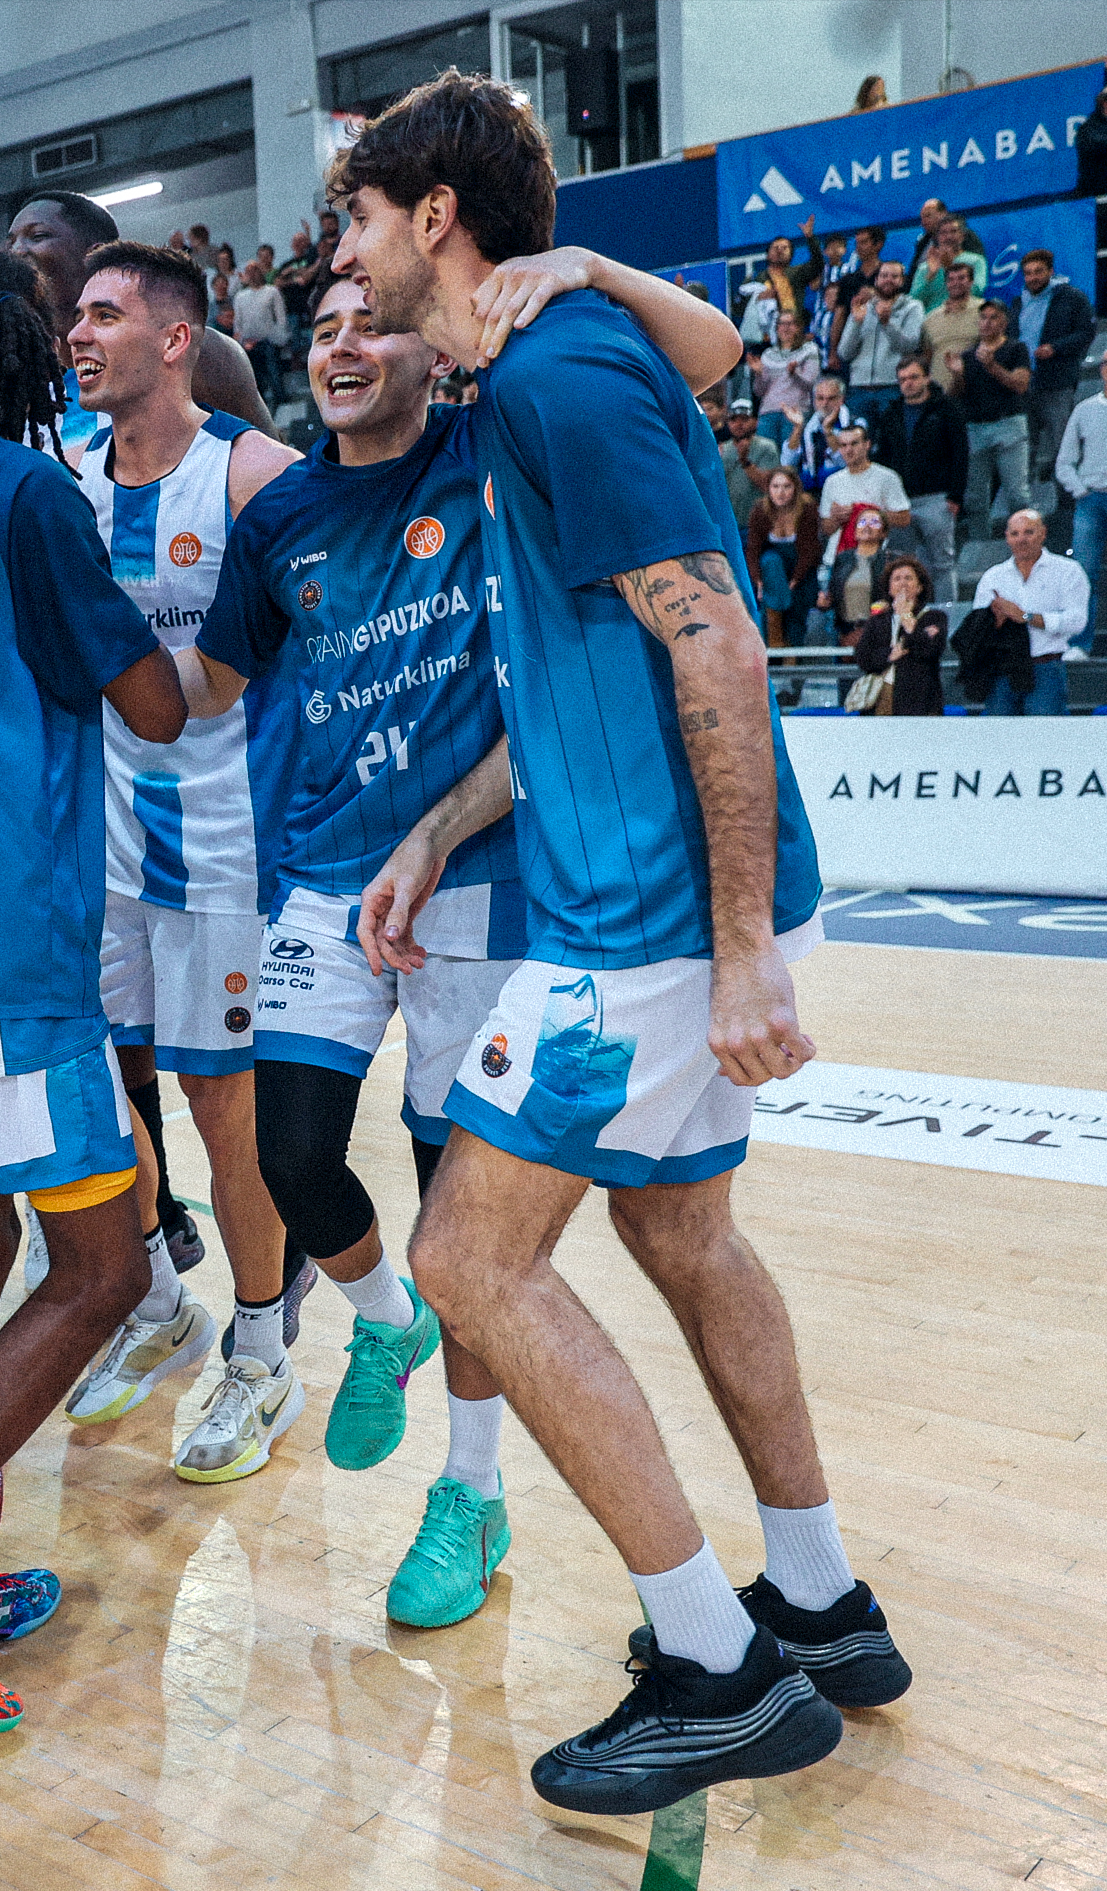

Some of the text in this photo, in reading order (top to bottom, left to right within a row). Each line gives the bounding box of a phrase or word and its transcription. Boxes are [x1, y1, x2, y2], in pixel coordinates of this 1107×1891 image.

[148, 606, 205, 628] rklim
[337, 650, 470, 712] Naturklima
[829, 768, 1107, 800] AMENABA
[261, 961, 316, 977] HYUNDAI
[289, 978, 315, 991] Car
